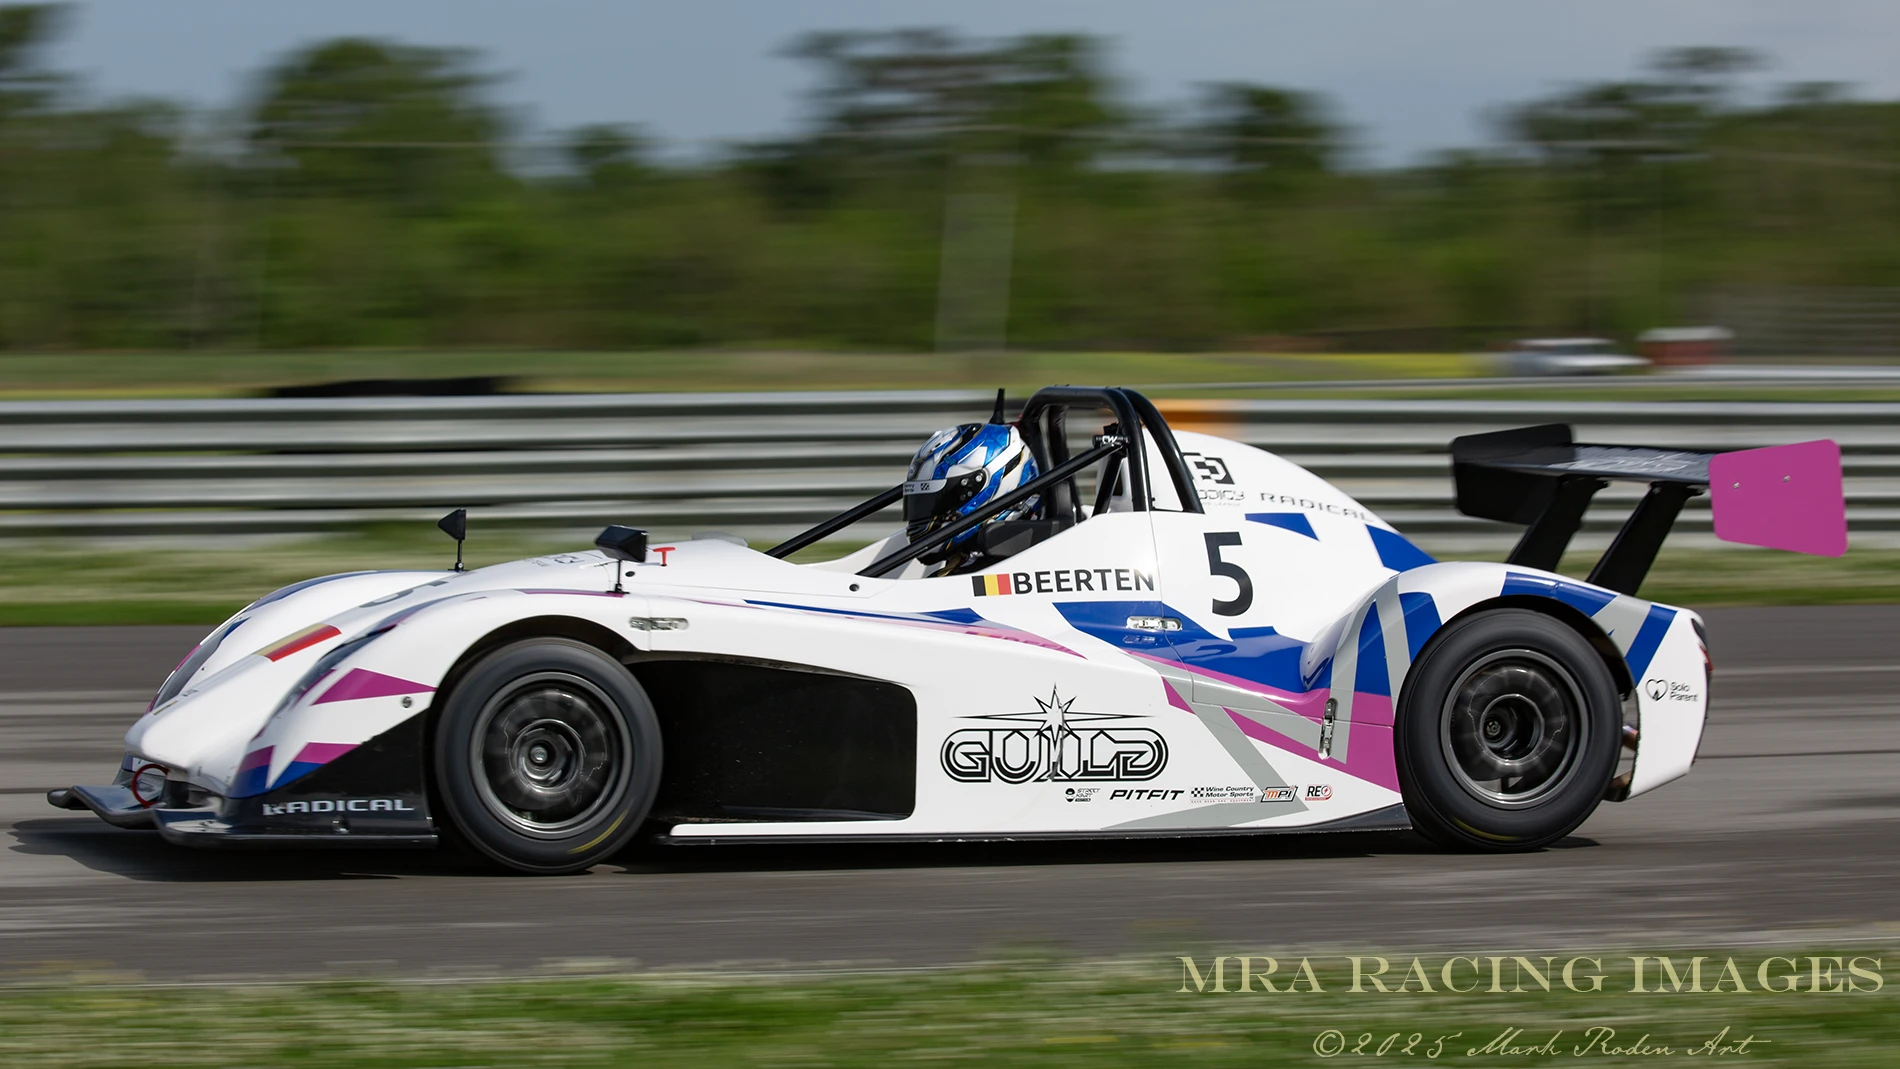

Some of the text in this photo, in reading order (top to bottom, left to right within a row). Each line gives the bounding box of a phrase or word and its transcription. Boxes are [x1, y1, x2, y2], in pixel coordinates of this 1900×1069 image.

[1260, 492, 1375, 522] RADICAL
[1012, 568, 1155, 595] BEERTEN
[1203, 531, 1254, 617] 5
[940, 727, 1169, 785] GUILD
[1109, 789, 1185, 801] PITFIT
[1226, 785, 1255, 793] Country
[1229, 791, 1254, 799] Sports
[262, 799, 415, 816] RADICAL
